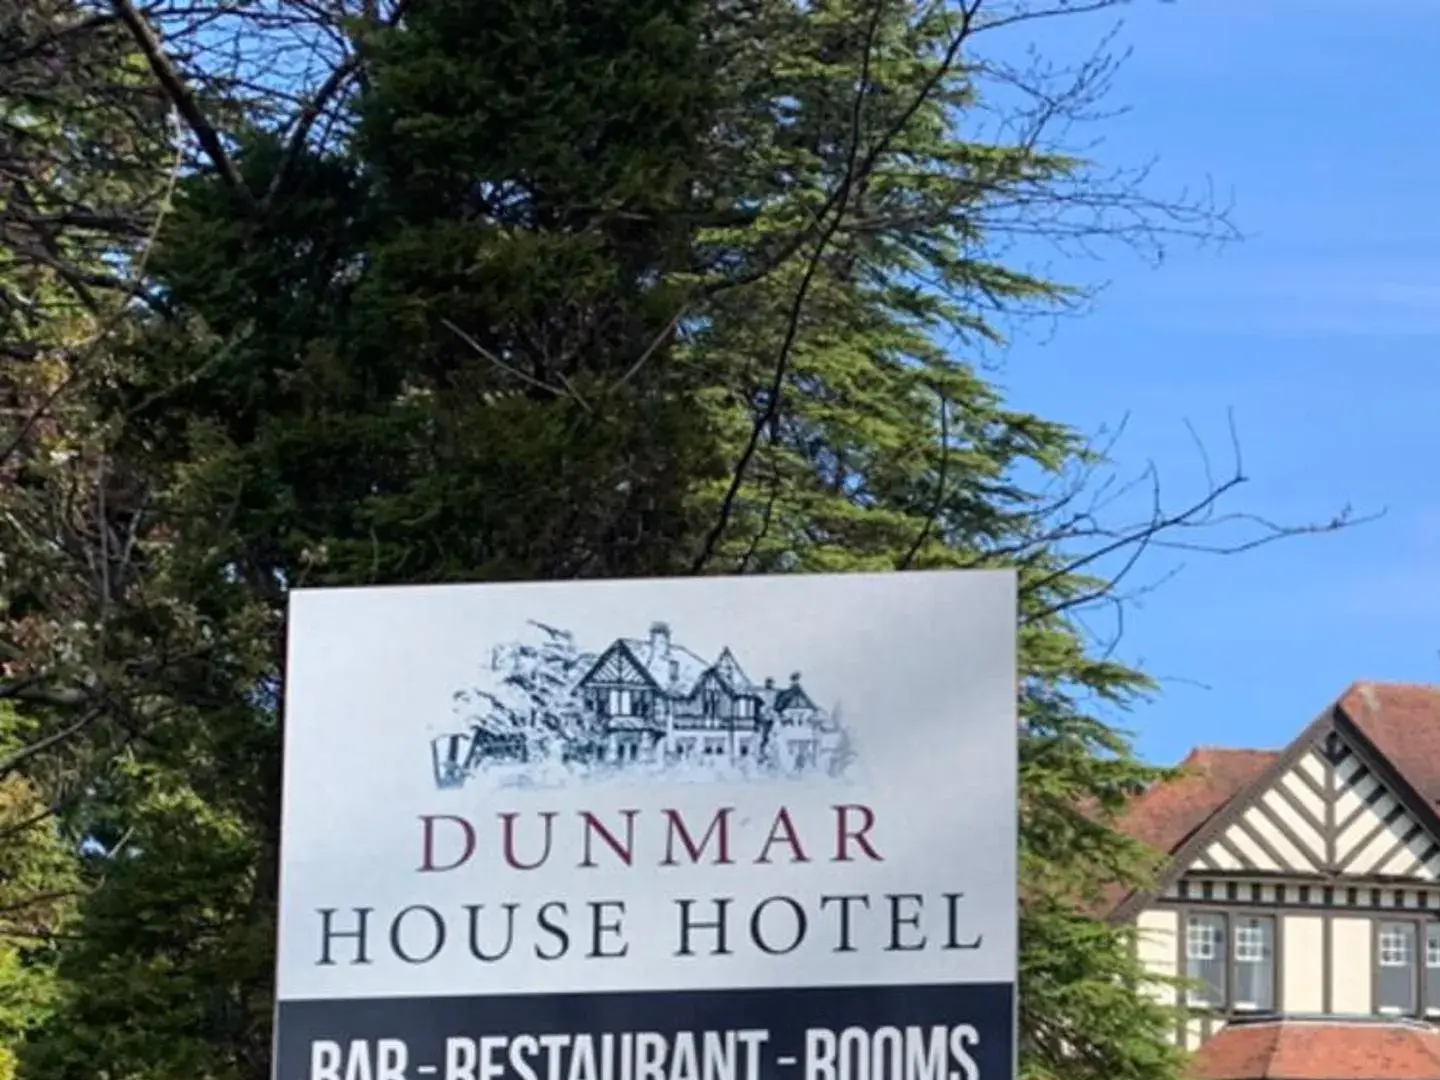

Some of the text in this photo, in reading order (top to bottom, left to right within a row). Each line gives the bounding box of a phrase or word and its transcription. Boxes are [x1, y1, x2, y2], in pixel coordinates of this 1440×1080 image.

[416, 803, 885, 873] DUNMAR
[314, 891, 983, 966] HOUSE HOTEL
